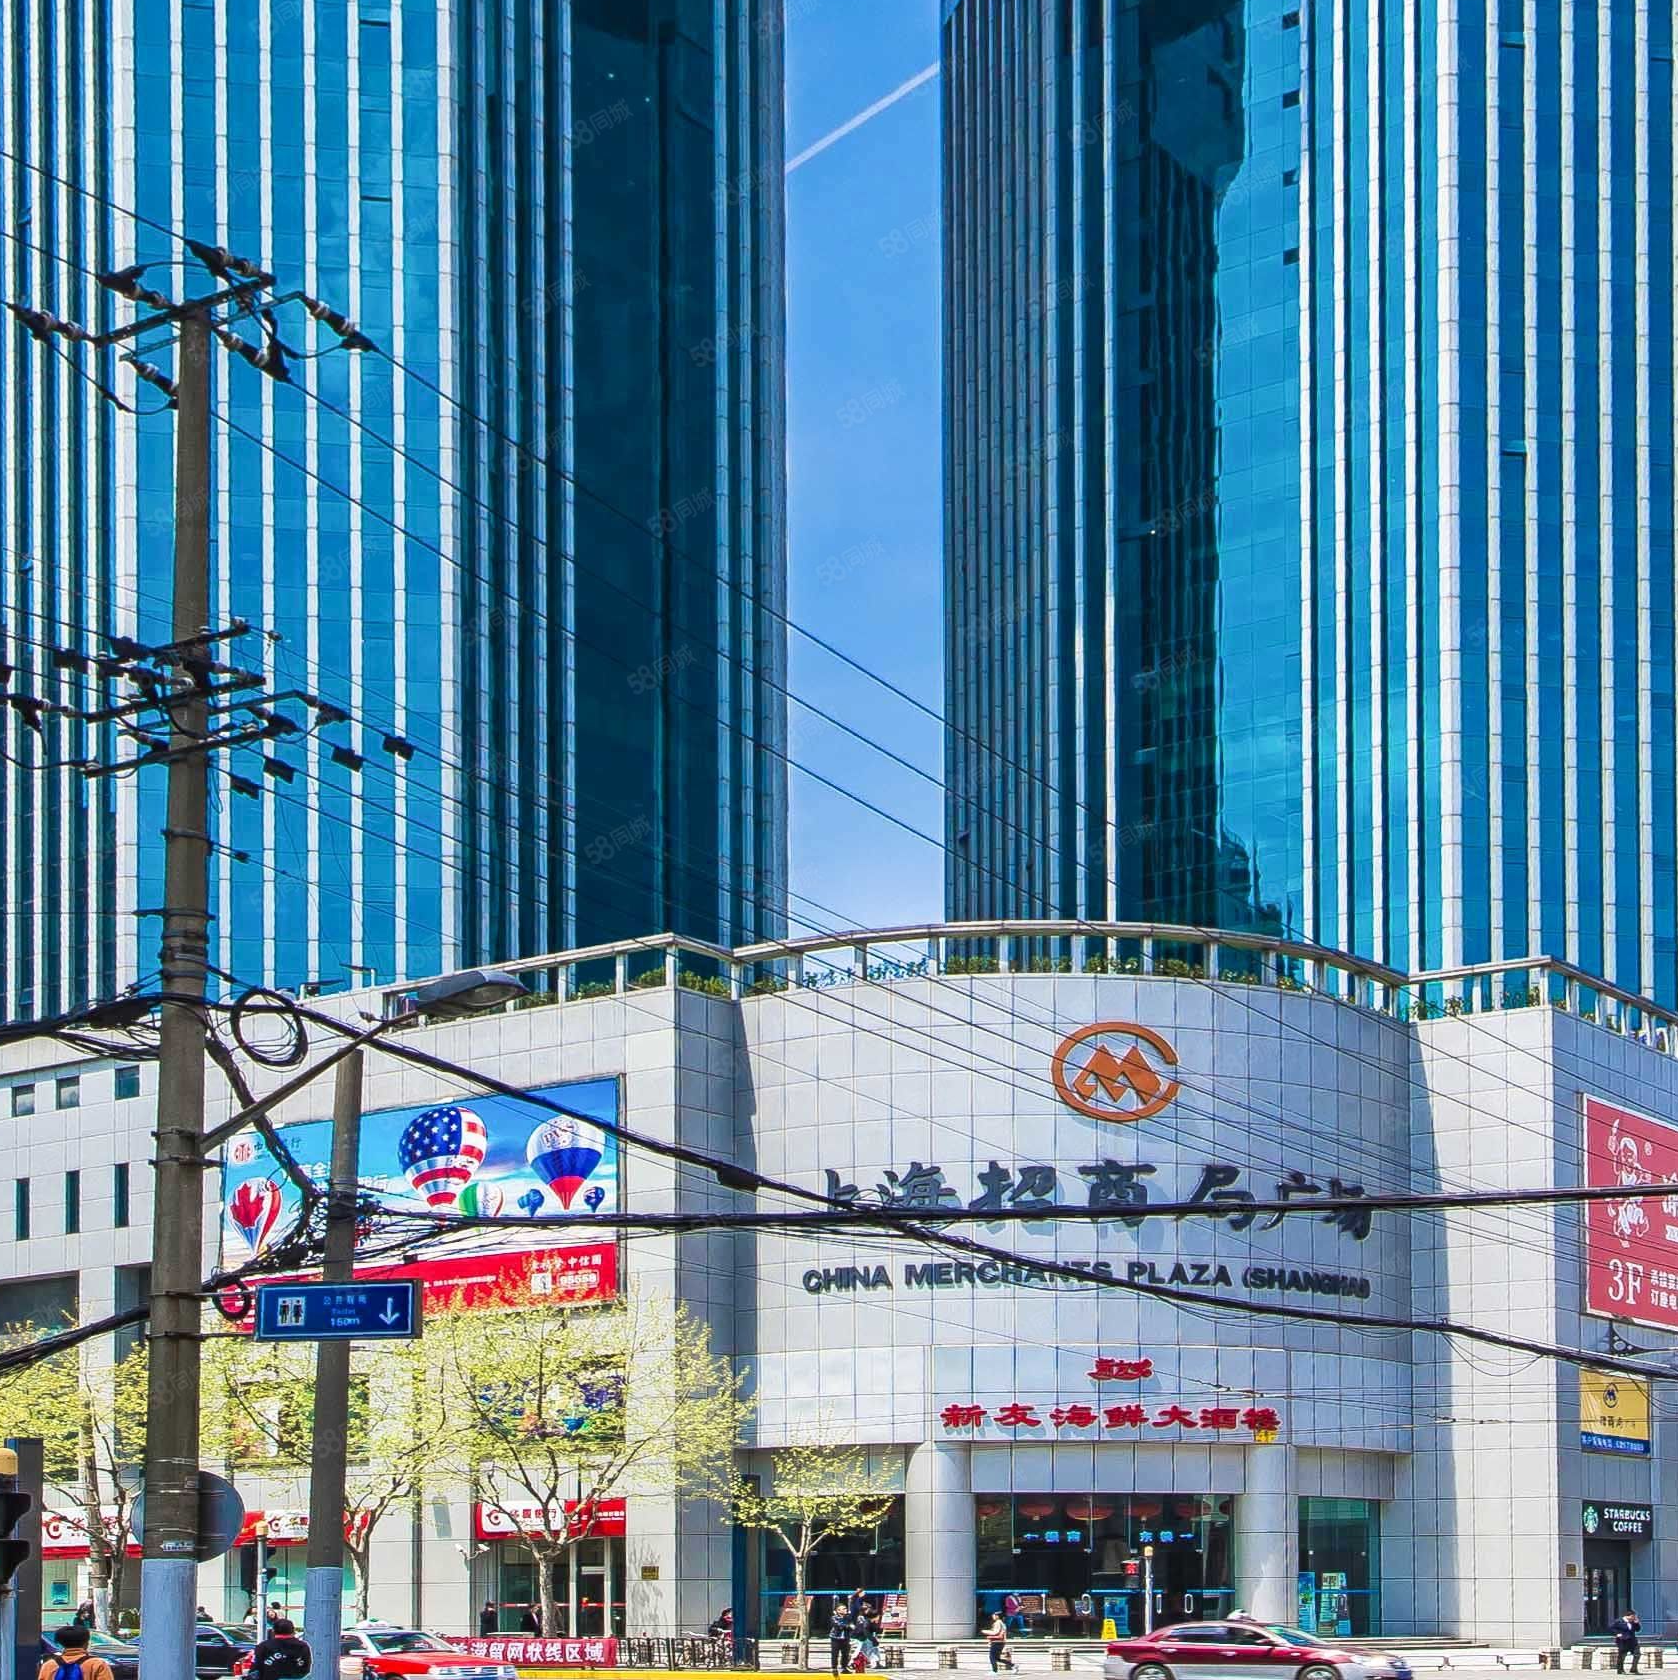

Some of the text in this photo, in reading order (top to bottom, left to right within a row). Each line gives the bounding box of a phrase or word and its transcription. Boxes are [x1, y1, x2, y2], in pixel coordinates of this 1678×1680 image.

[802, 1264, 893, 1294] CHINA
[904, 1261, 1114, 1287] MERCHANTS
[1127, 1261, 1232, 1287] PLAZA
[1608, 1258, 1643, 1305] 3F
[1603, 1507, 1651, 1521] STARBUCKS
[1612, 1521, 1643, 1533] COFFEE
